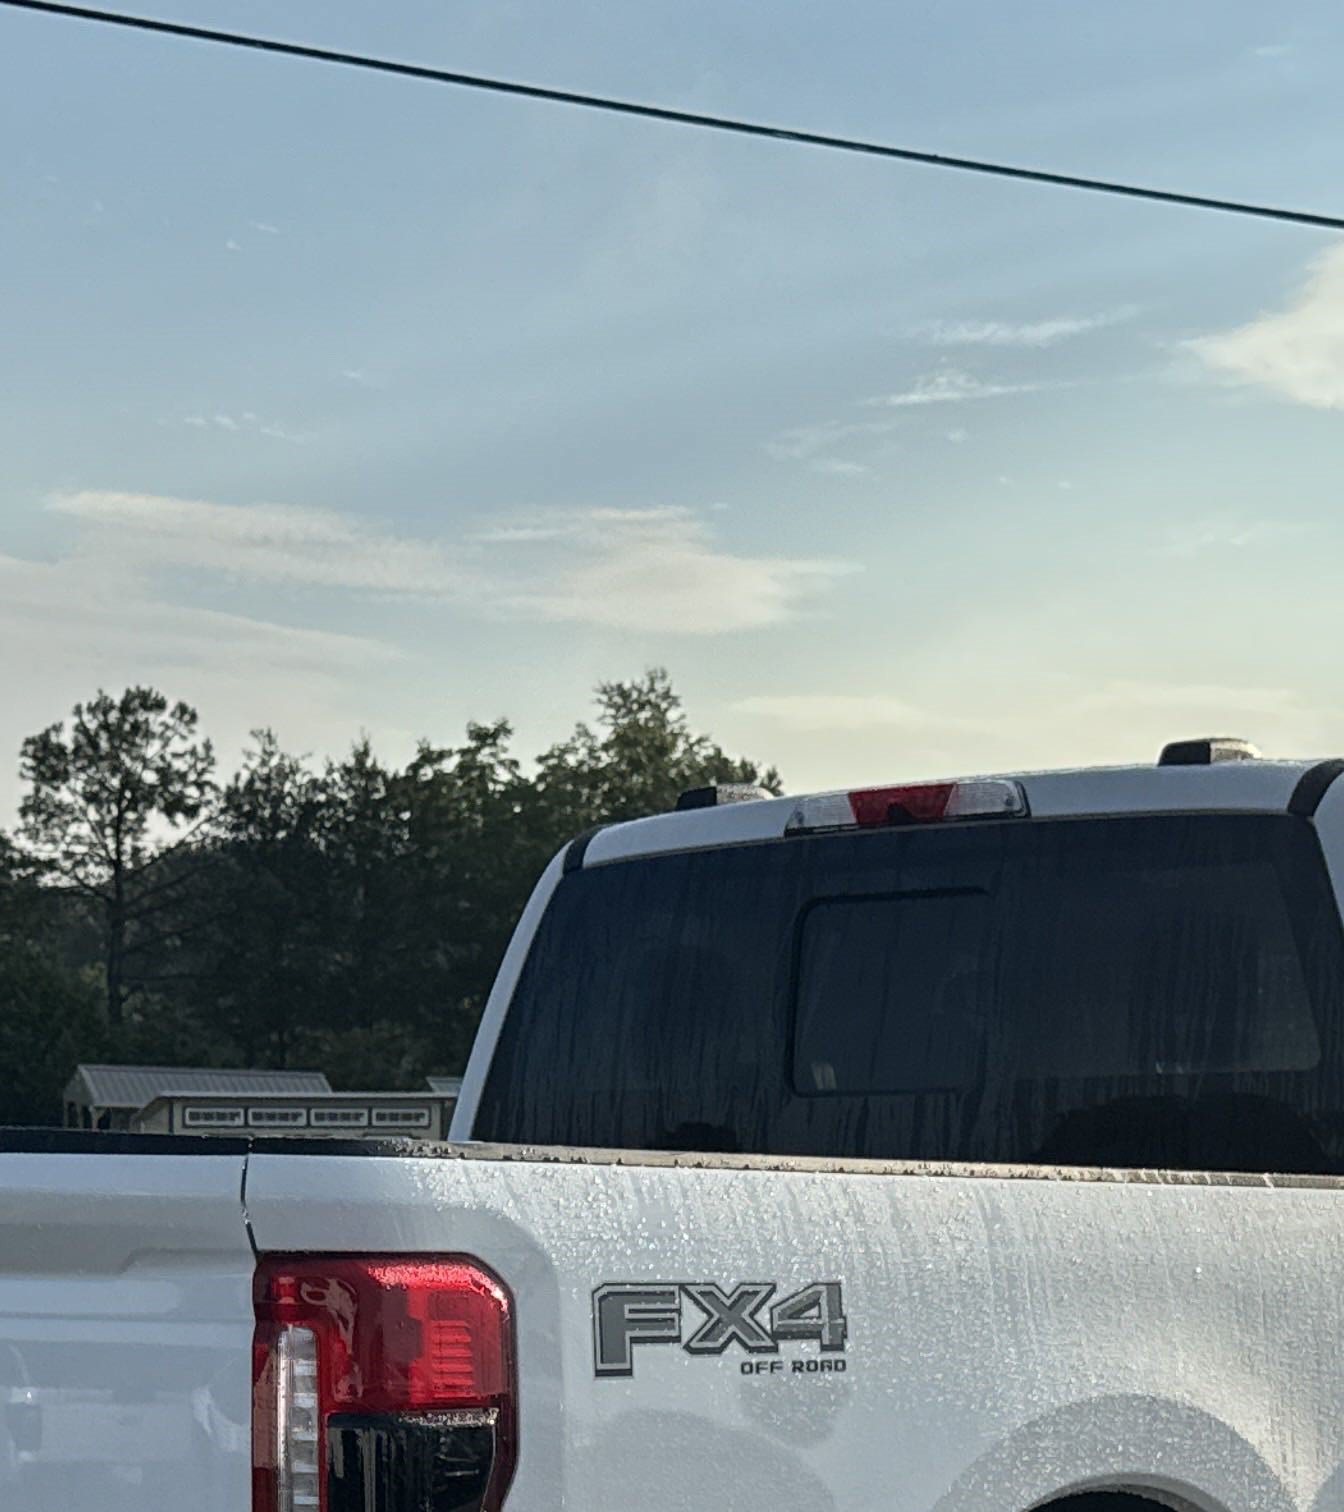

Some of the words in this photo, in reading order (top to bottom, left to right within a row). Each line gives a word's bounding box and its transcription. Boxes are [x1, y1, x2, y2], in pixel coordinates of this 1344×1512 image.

[591, 1281, 848, 1378] FX4
[740, 1361, 784, 1375] OFF
[791, 1359, 847, 1373] ROAD
